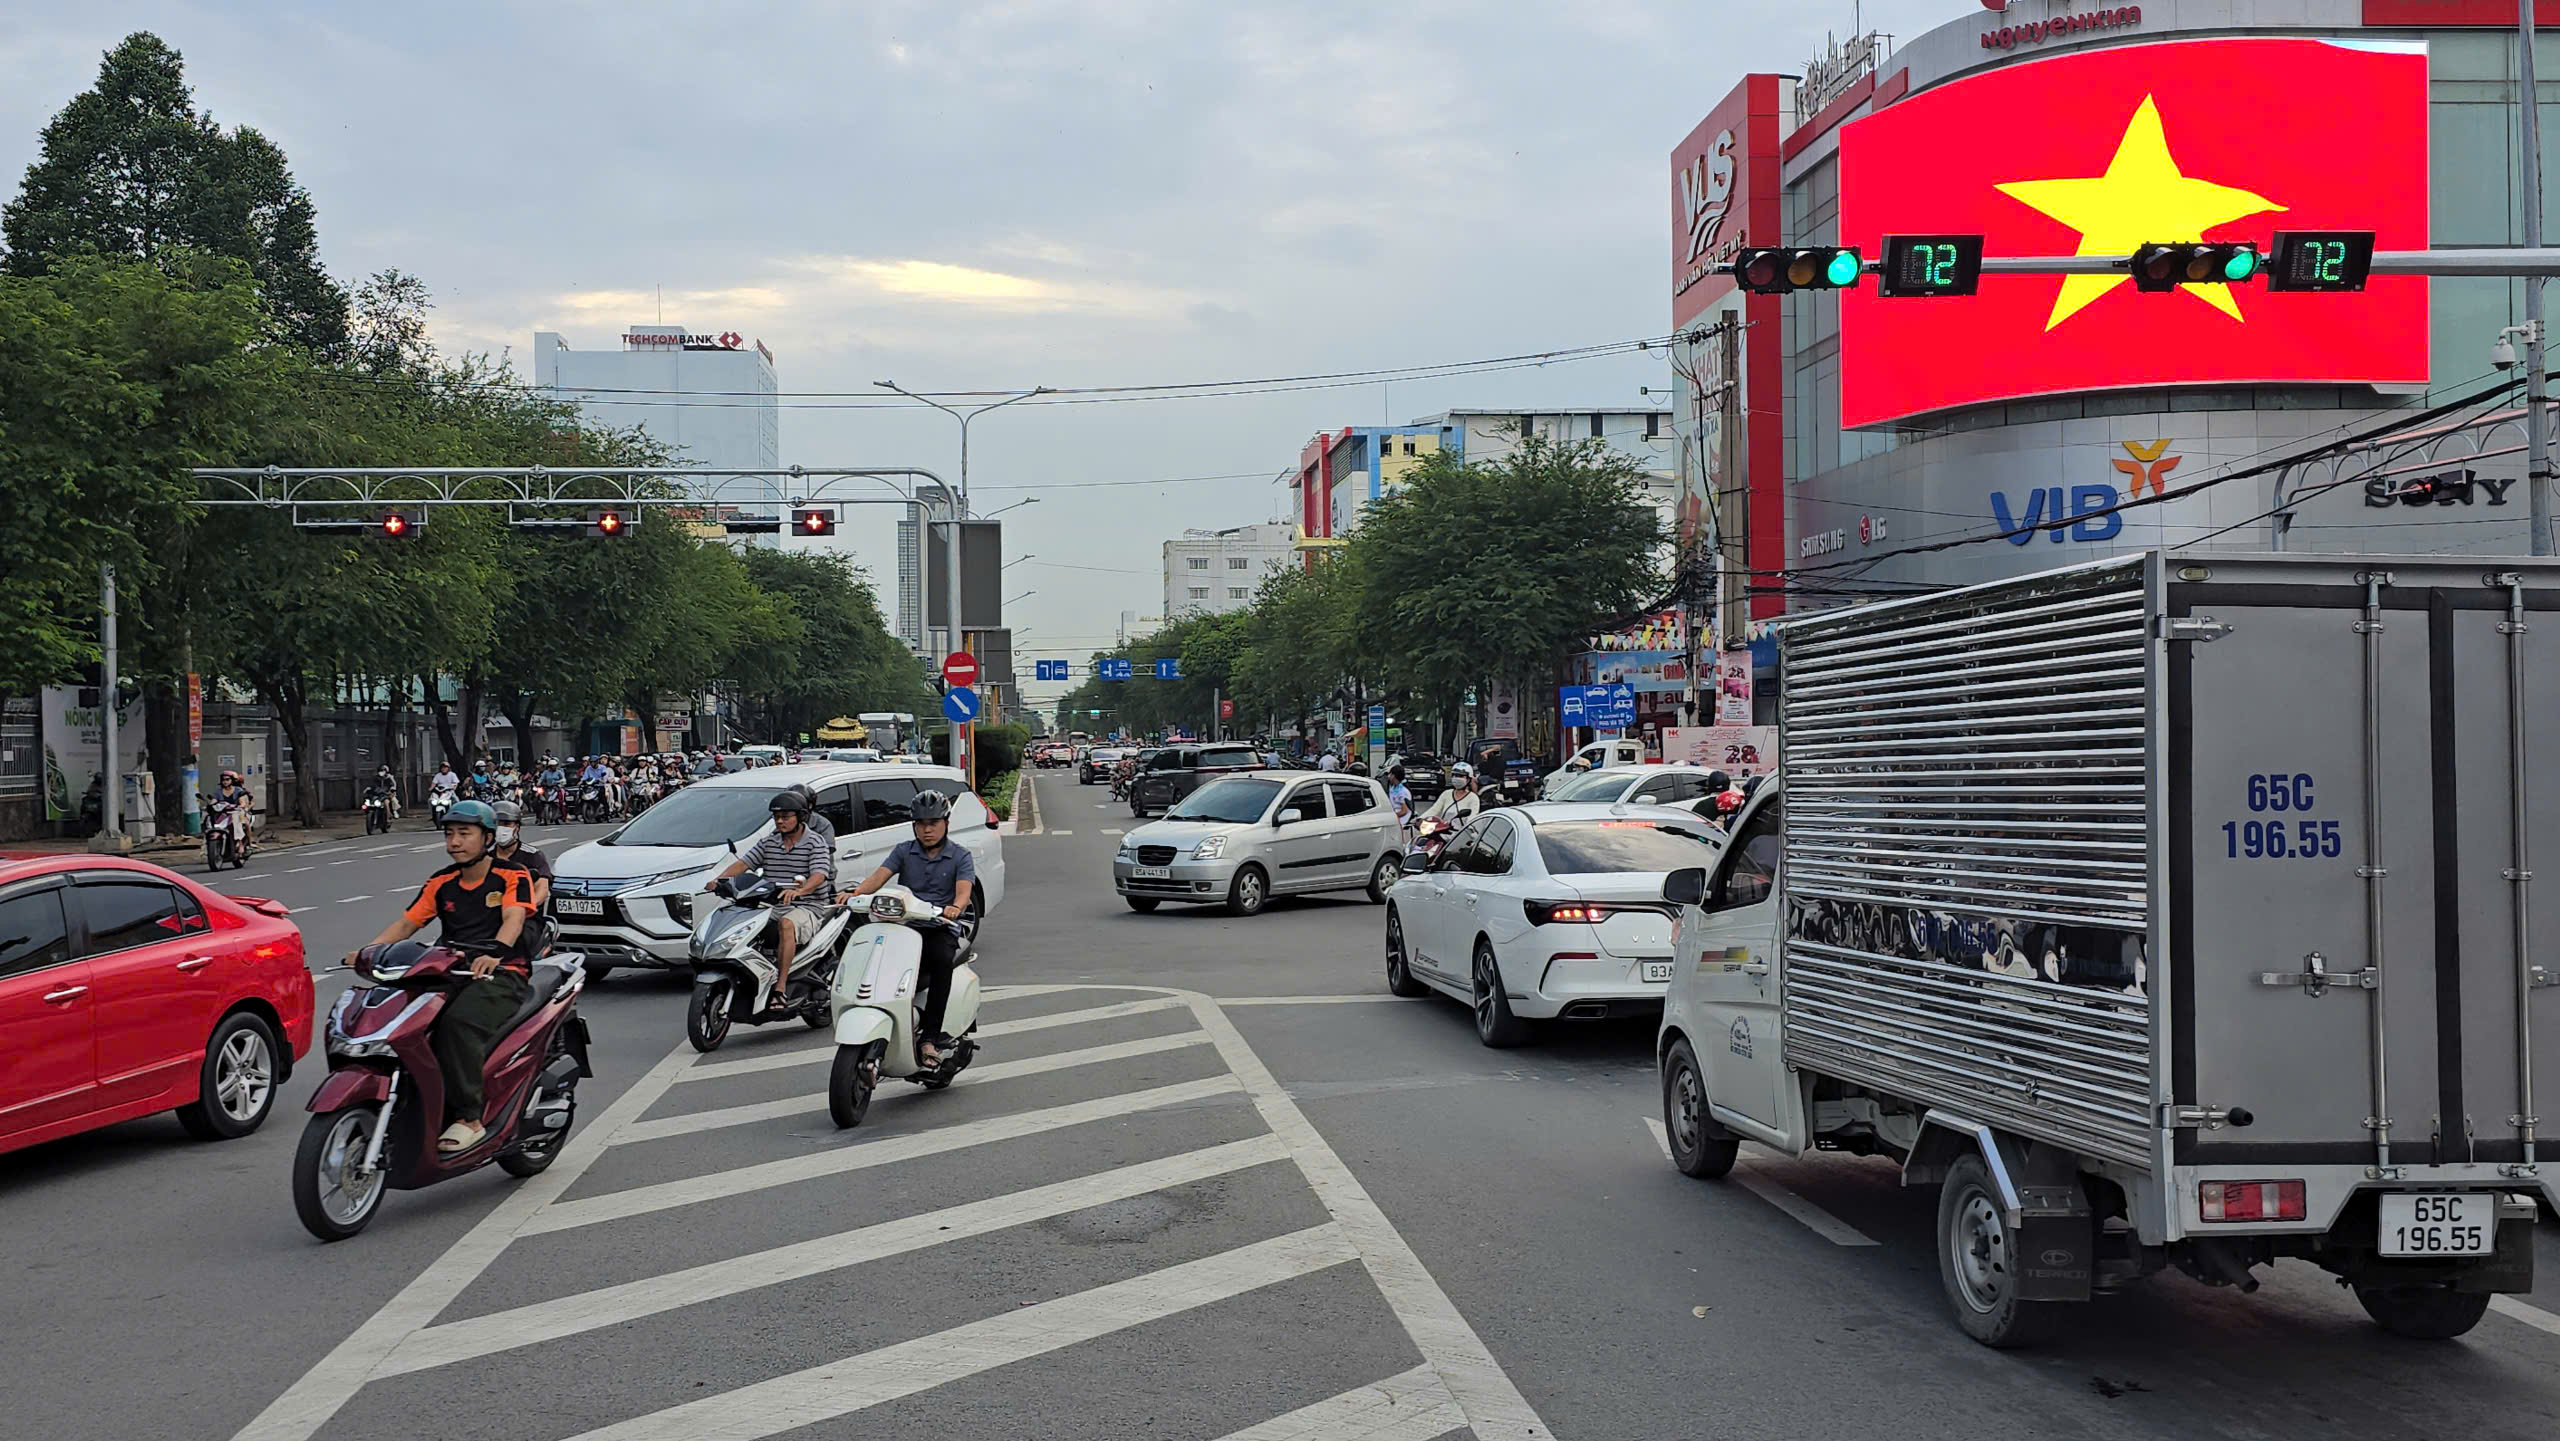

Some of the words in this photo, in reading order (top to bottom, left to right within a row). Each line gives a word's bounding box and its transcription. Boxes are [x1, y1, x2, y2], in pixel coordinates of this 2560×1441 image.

[1913, 244, 1957, 285] 72
[2304, 241, 2346, 281] 72
[621, 333, 713, 345] TECHCOMBANK
[1871, 517, 1886, 541] LG
[1990, 484, 2123, 547] VIB
[1801, 528, 1845, 559] SAMSUNG
[2247, 773, 2314, 812] 65C
[2221, 820, 2341, 859] 196.55
[2415, 1197, 2463, 1222] 65C
[2396, 1226, 2482, 1252] 196.55
